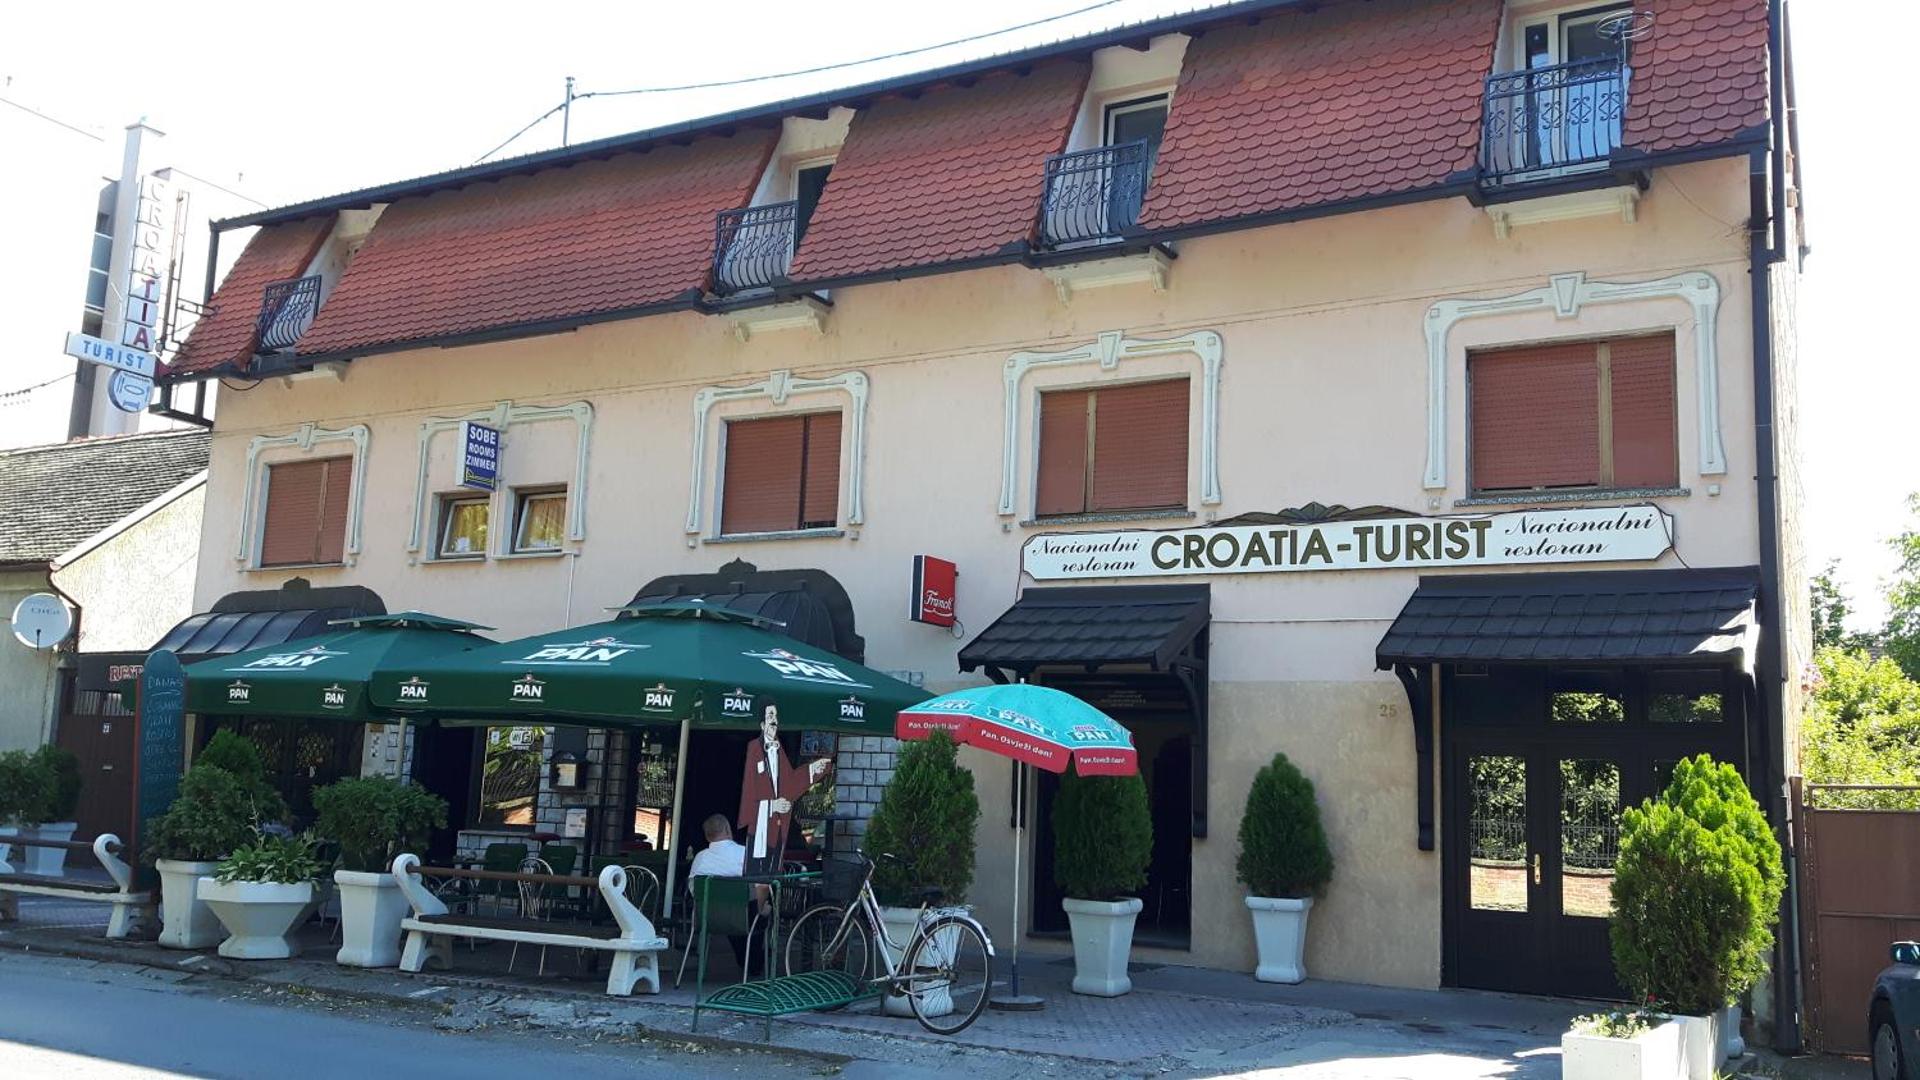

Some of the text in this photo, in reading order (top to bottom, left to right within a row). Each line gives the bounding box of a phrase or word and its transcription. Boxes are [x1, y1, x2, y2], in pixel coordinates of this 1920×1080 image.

[132, 182, 166, 350] CROATIA
[83, 340, 145, 369] TURIST
[469, 426, 496, 445] SOBE
[468, 442, 496, 459] ROOMS
[466, 455, 496, 471] ZIMMER
[1504, 510, 1656, 536] Nacionalni
[1031, 535, 1141, 555] Nacionalni
[1150, 519, 1493, 571] CROATIA-TURIST
[1503, 537, 1609, 559] restoran
[1061, 554, 1140, 573] restoran
[522, 647, 634, 662] PAN
[761, 658, 857, 683] PAN
[229, 688, 249, 700] PAN
[324, 692, 345, 705] PAN
[401, 685, 427, 698] PAN
[513, 684, 543, 698] PAN
[645, 693, 673, 707] PAN
[723, 698, 751, 712] PAN
[840, 704, 864, 718] PAN
[1379, 704, 1397, 717] 25
[980, 729, 1000, 742] Pan.
[1075, 732, 1111, 742] PAN
